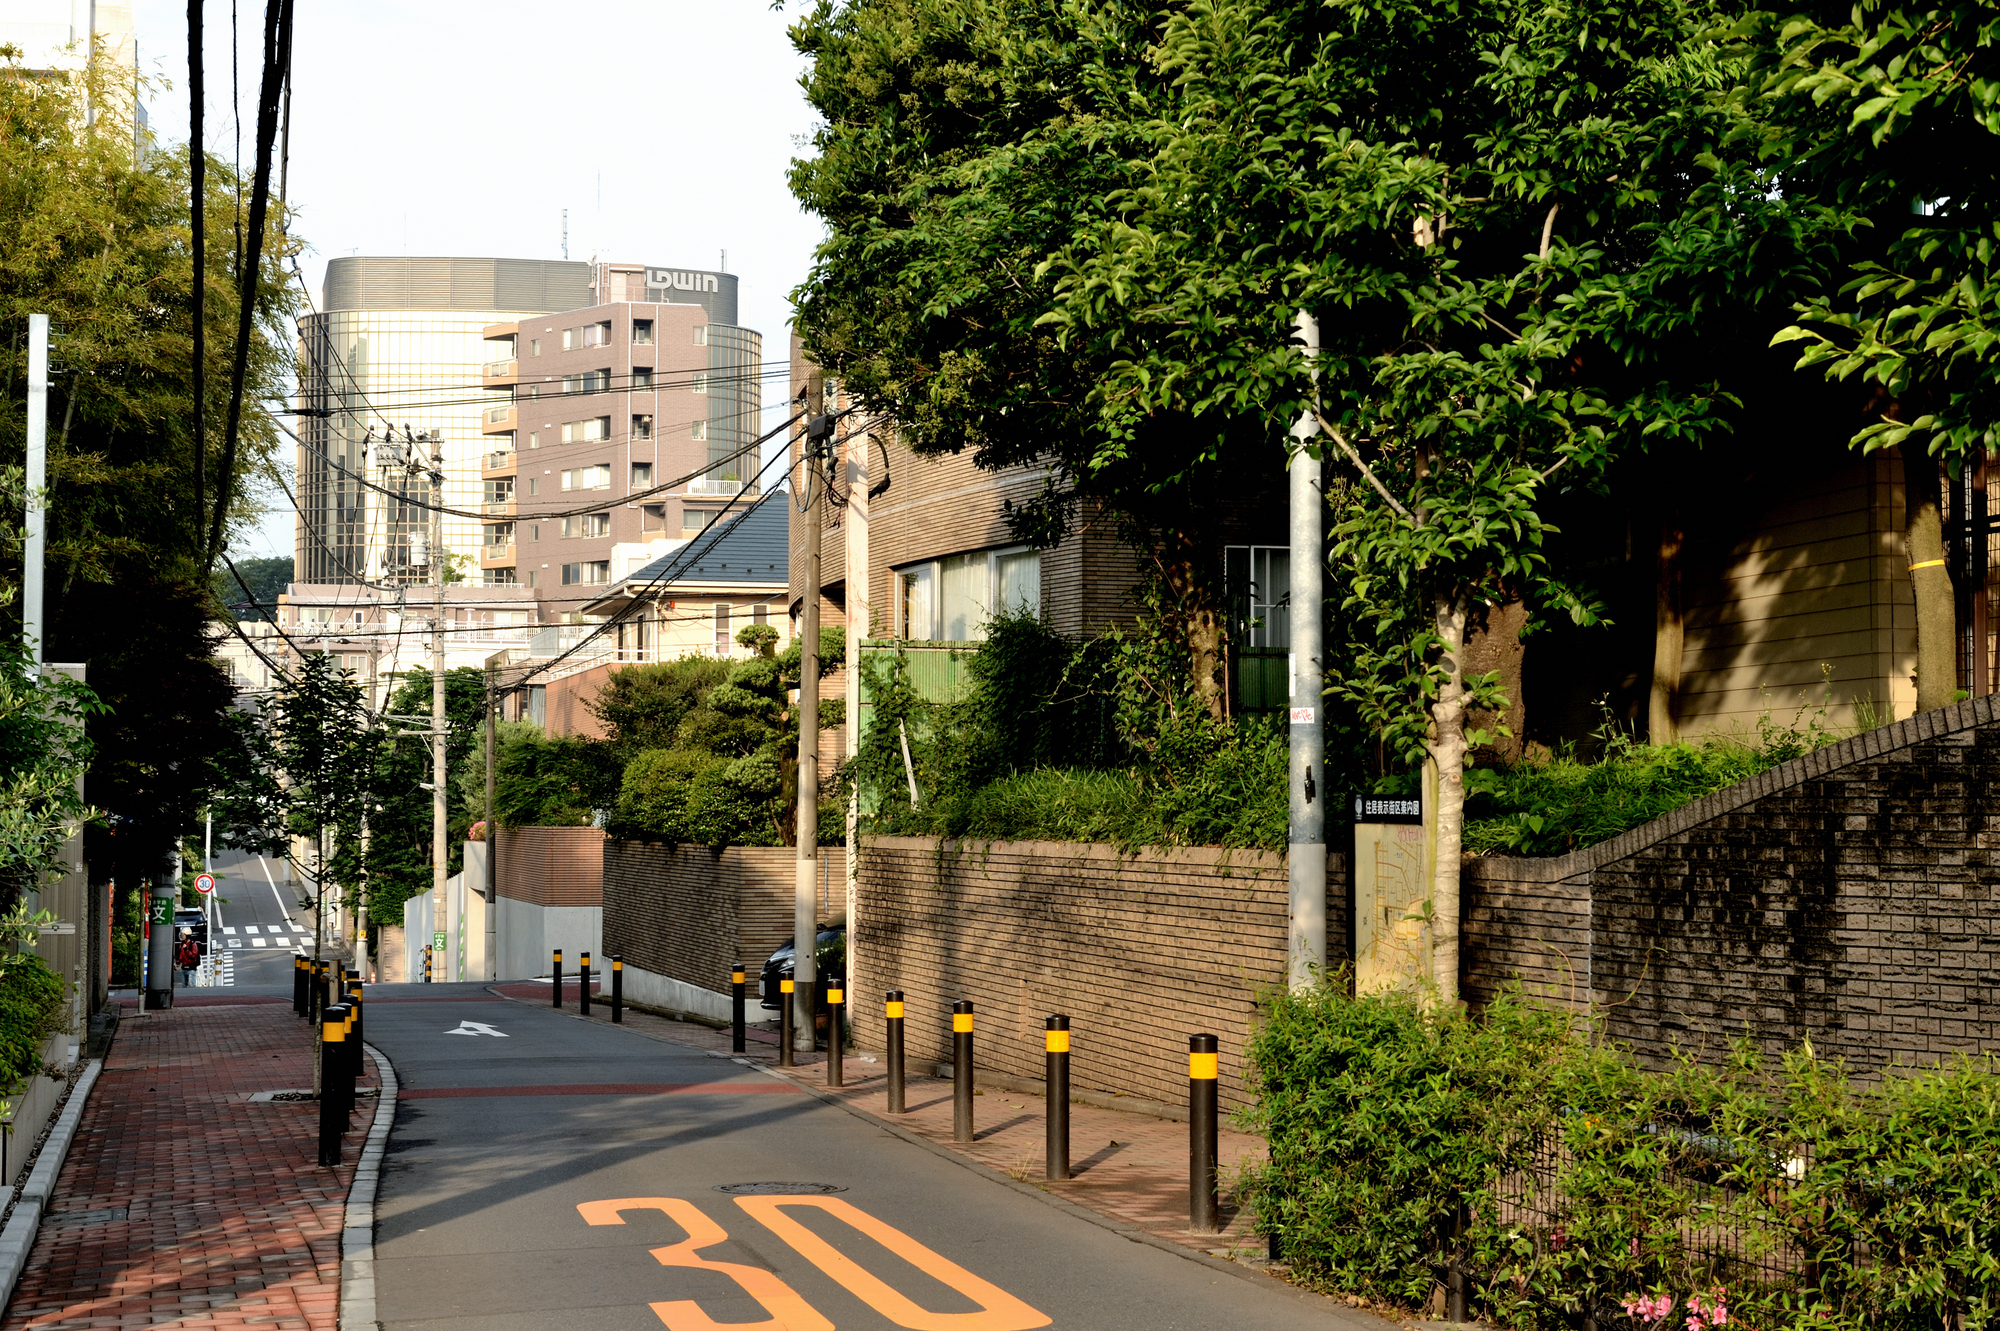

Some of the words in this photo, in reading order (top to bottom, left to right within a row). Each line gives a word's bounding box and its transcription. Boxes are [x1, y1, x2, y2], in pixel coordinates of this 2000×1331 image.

[199, 879, 211, 889] 30
[152, 905, 166, 921] 文
[434, 937, 444, 948] 文
[576, 1194, 1054, 1331] 30
